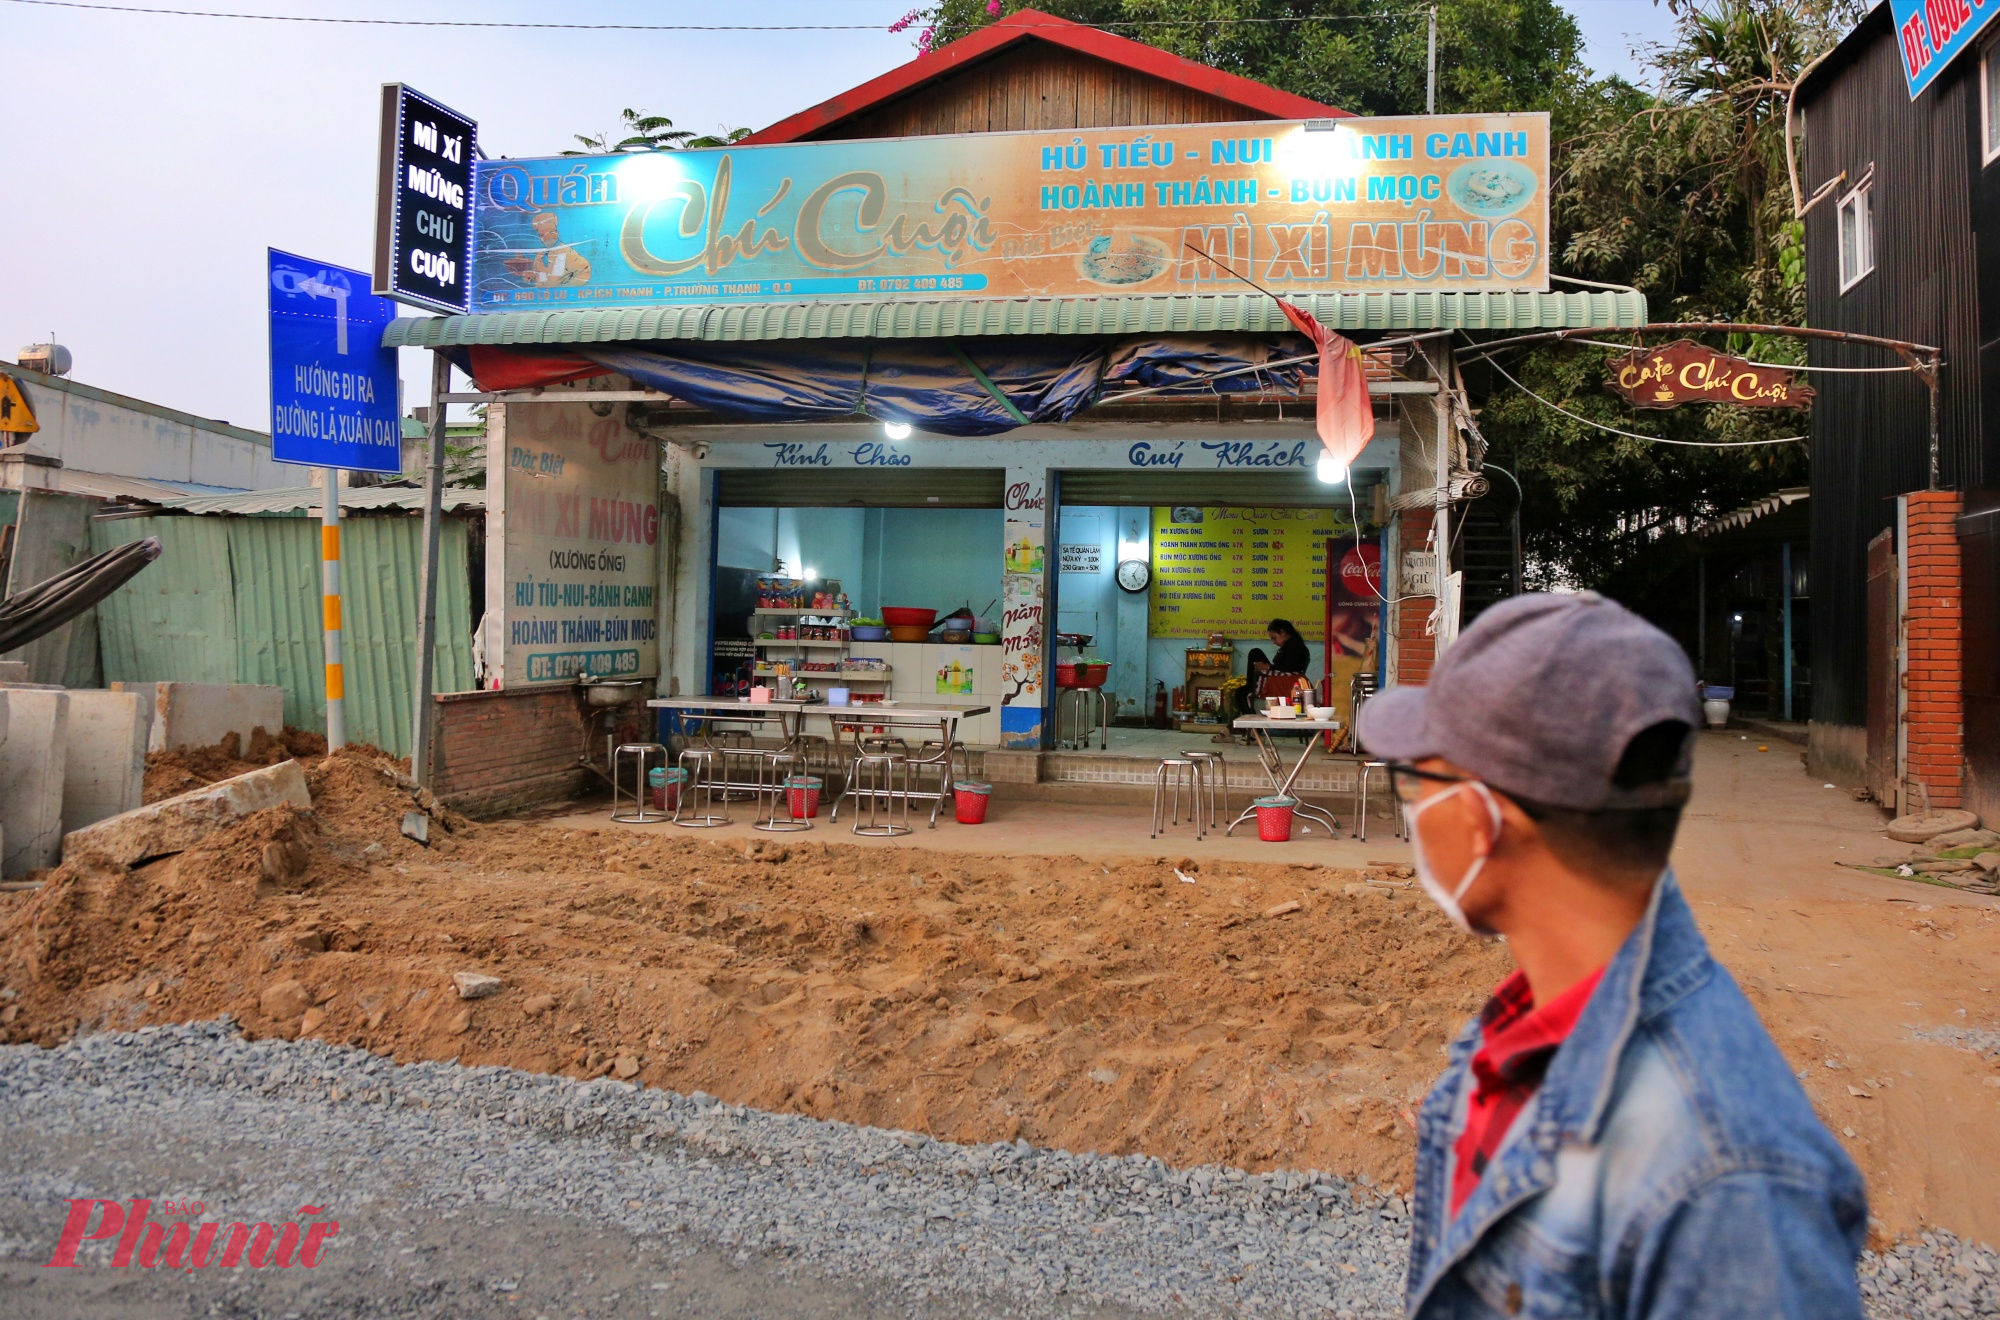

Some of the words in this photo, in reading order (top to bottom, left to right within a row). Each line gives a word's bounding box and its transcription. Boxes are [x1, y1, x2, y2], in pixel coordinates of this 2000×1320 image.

[1902, 11, 1931, 79] ĐT:
[414, 120, 437, 153] MÌ
[442, 134, 462, 164] XÍ
[1042, 138, 1087, 171] HỦ
[1099, 134, 1174, 168] TIẾU
[1211, 138, 1273, 164] NUI
[1426, 132, 1526, 158] CANH
[409, 165, 463, 210] MỨNG
[488, 164, 618, 213] Quán
[1041, 180, 1144, 210] HOÀNH
[1155, 176, 1257, 206] THÁNH
[1368, 175, 1440, 206] MỌC
[417, 210, 453, 243] CHÚ
[620, 154, 792, 277] Chú
[793, 170, 998, 272] Cuội
[1176, 212, 1253, 283] MÌ
[1264, 211, 1331, 280] XÍ
[1345, 209, 1537, 280] MỨNG
[411, 249, 455, 287] CUỘI
[880, 278, 910, 290] 0792
[914, 278, 936, 289] 409
[940, 277, 963, 288] 485
[295, 361, 339, 398] HƯỚNG
[342, 373, 355, 401] ĐI
[358, 376, 374, 404] RA
[1680, 357, 1731, 390] Chú
[1731, 373, 1788, 402] Cuội
[277, 400, 318, 438] ĐƯỜNG
[339, 410, 373, 444] XUÂN
[376, 420, 395, 447] OAI
[764, 443, 832, 468] Kính
[848, 443, 910, 466] Chào
[1200, 442, 1315, 468] Khách
[554, 485, 580, 538] XÍ
[589, 491, 658, 546] MỨNG
[550, 550, 595, 570] (XƯƠNG
[598, 549, 625, 572] ỐNG)
[516, 574, 534, 606] HỦ
[625, 586, 653, 607] CANH
[512, 616, 557, 645] HOÀNH
[631, 619, 655, 645] MỌC
[531, 656, 551, 678] ĐT:
[590, 653, 611, 674] 409
[615, 652, 636, 672] 485
